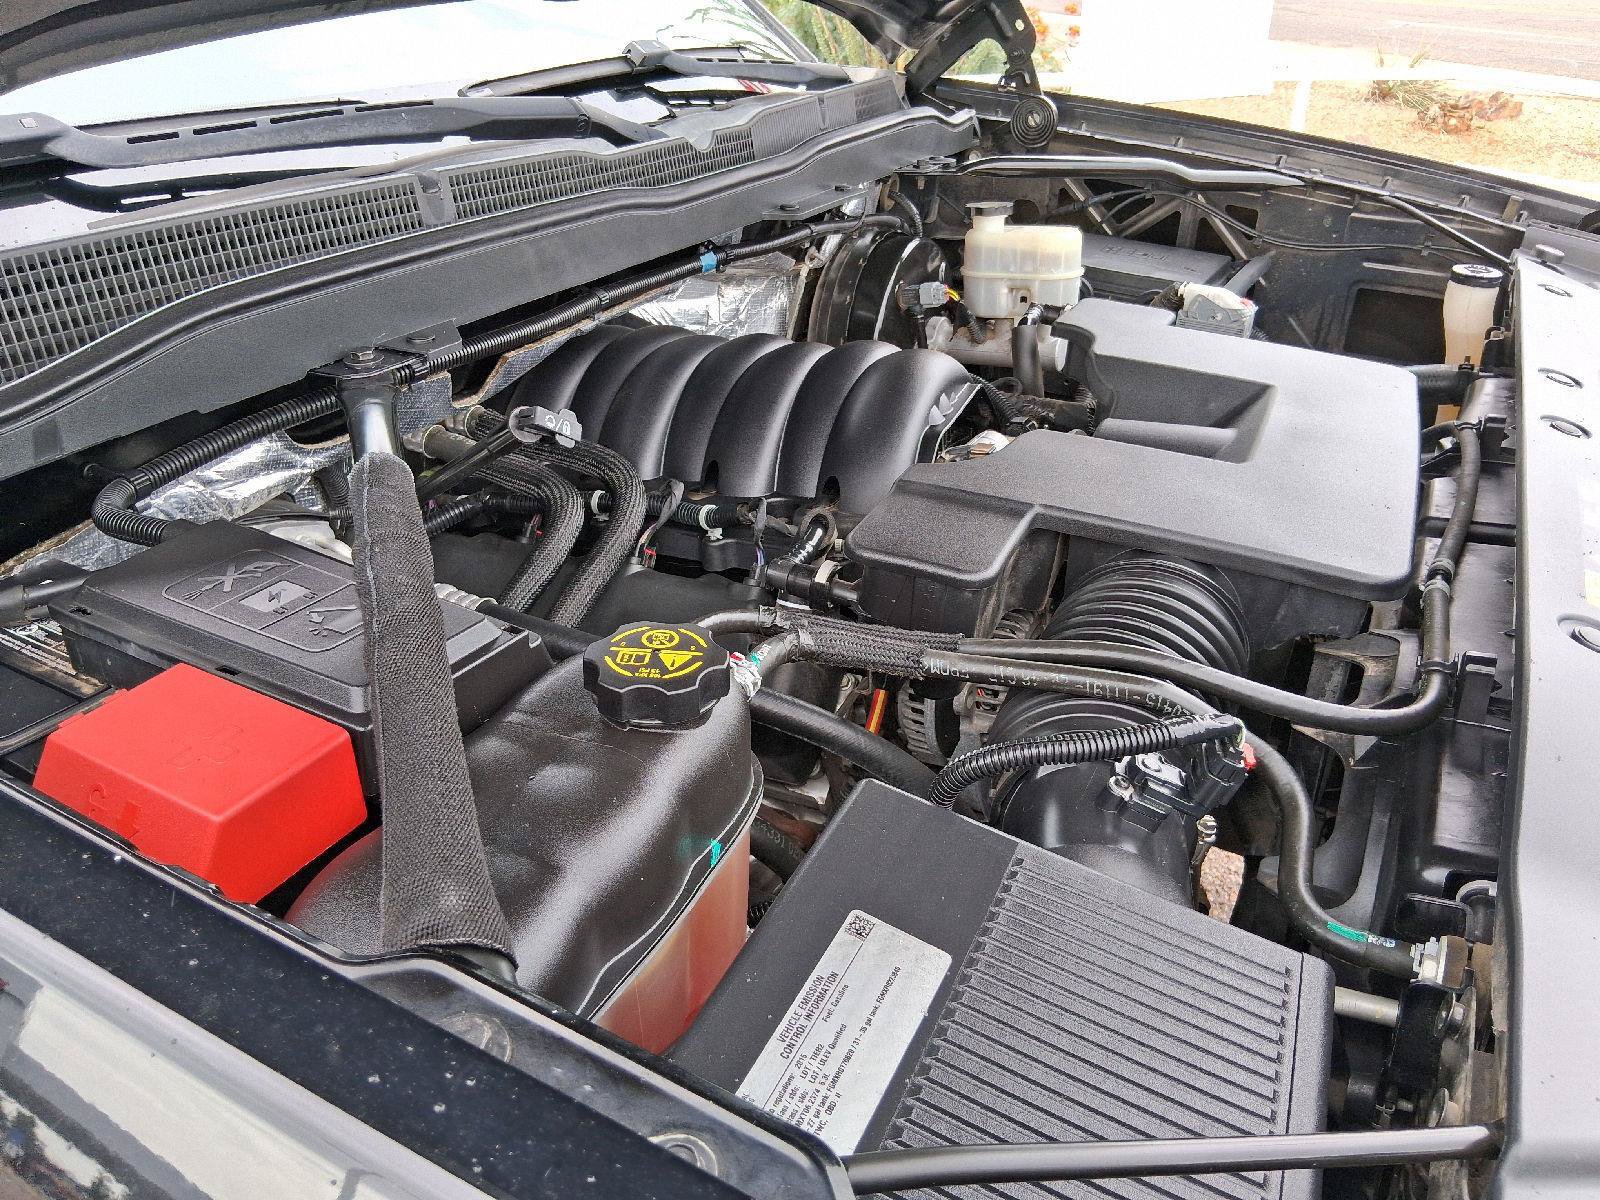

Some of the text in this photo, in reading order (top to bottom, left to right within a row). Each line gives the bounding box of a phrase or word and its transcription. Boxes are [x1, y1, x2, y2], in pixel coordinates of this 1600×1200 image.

[776, 973, 825, 1044] VEHICLE EMISSION
[779, 969, 839, 1060] CONTROL INFORMATION
